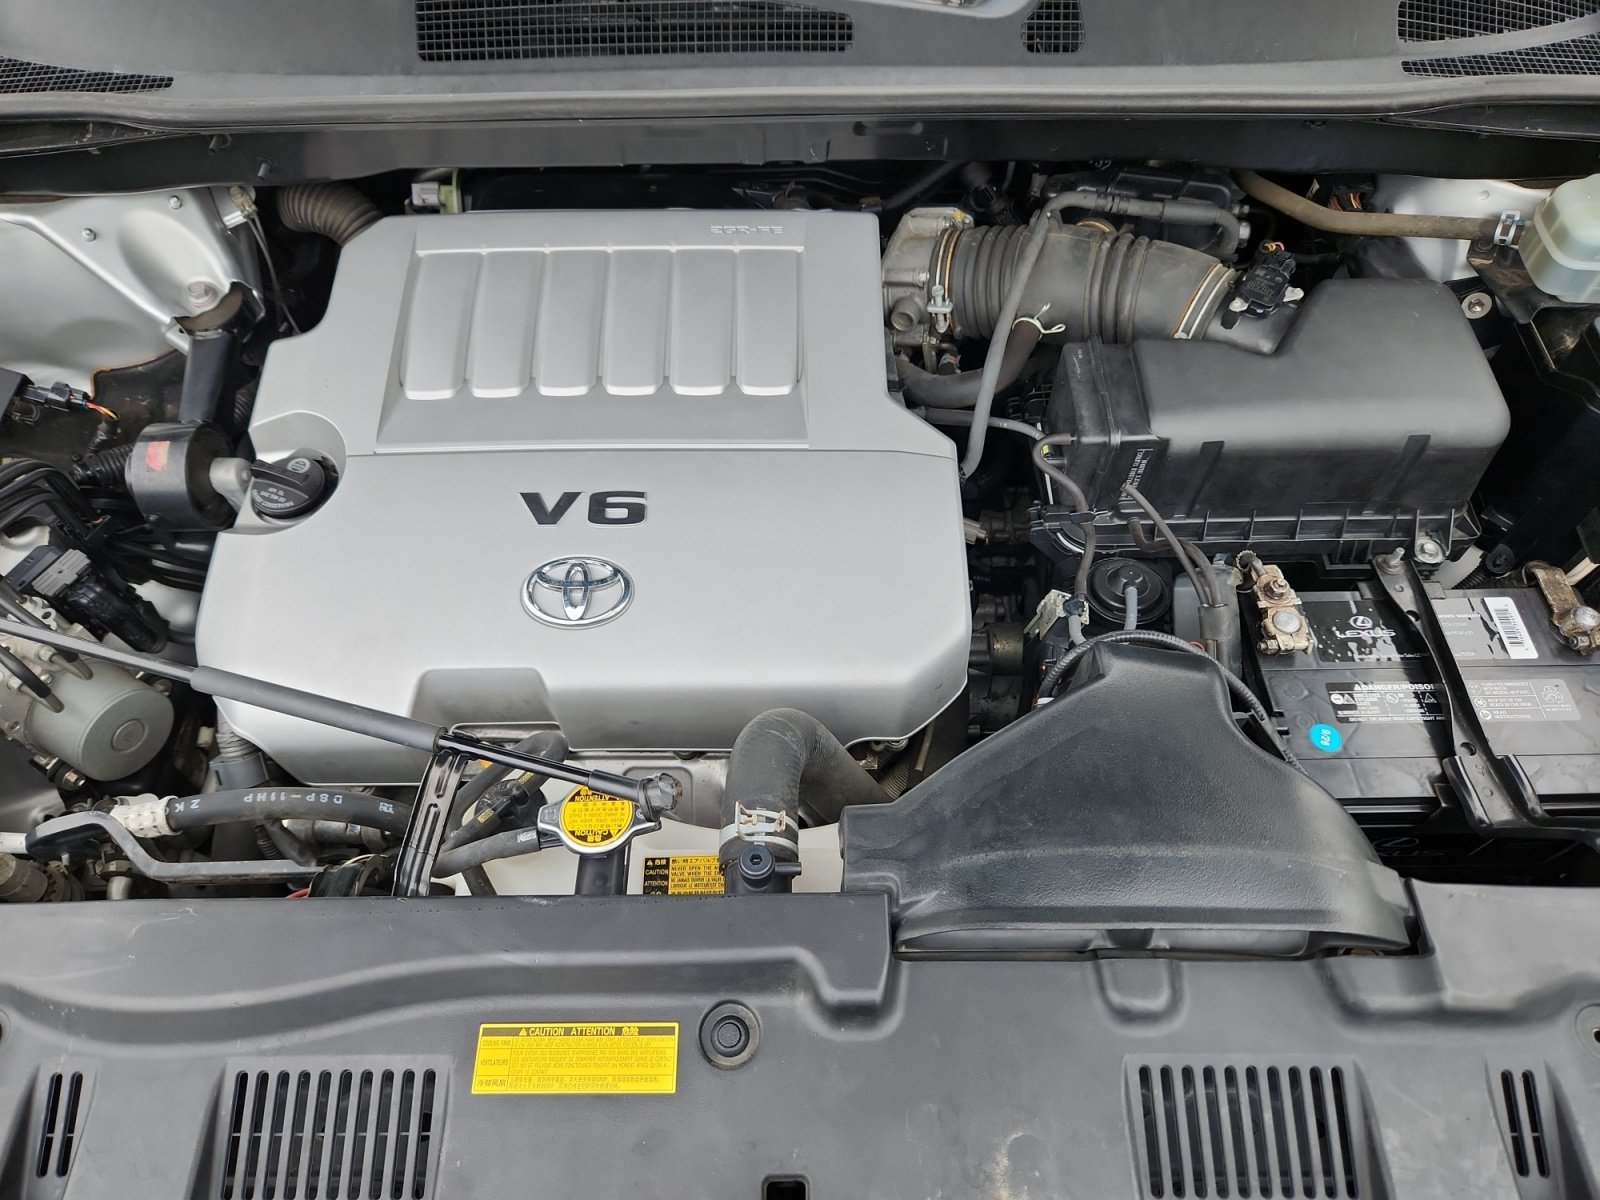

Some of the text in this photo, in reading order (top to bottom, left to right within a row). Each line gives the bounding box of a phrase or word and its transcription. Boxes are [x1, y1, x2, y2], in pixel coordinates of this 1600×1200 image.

[519, 490, 647, 526] V6
[1335, 629, 1397, 638] LEXUS
[574, 829, 609, 837] CAUTION
[529, 1027, 616, 1036] CAUTION ATTENTION
